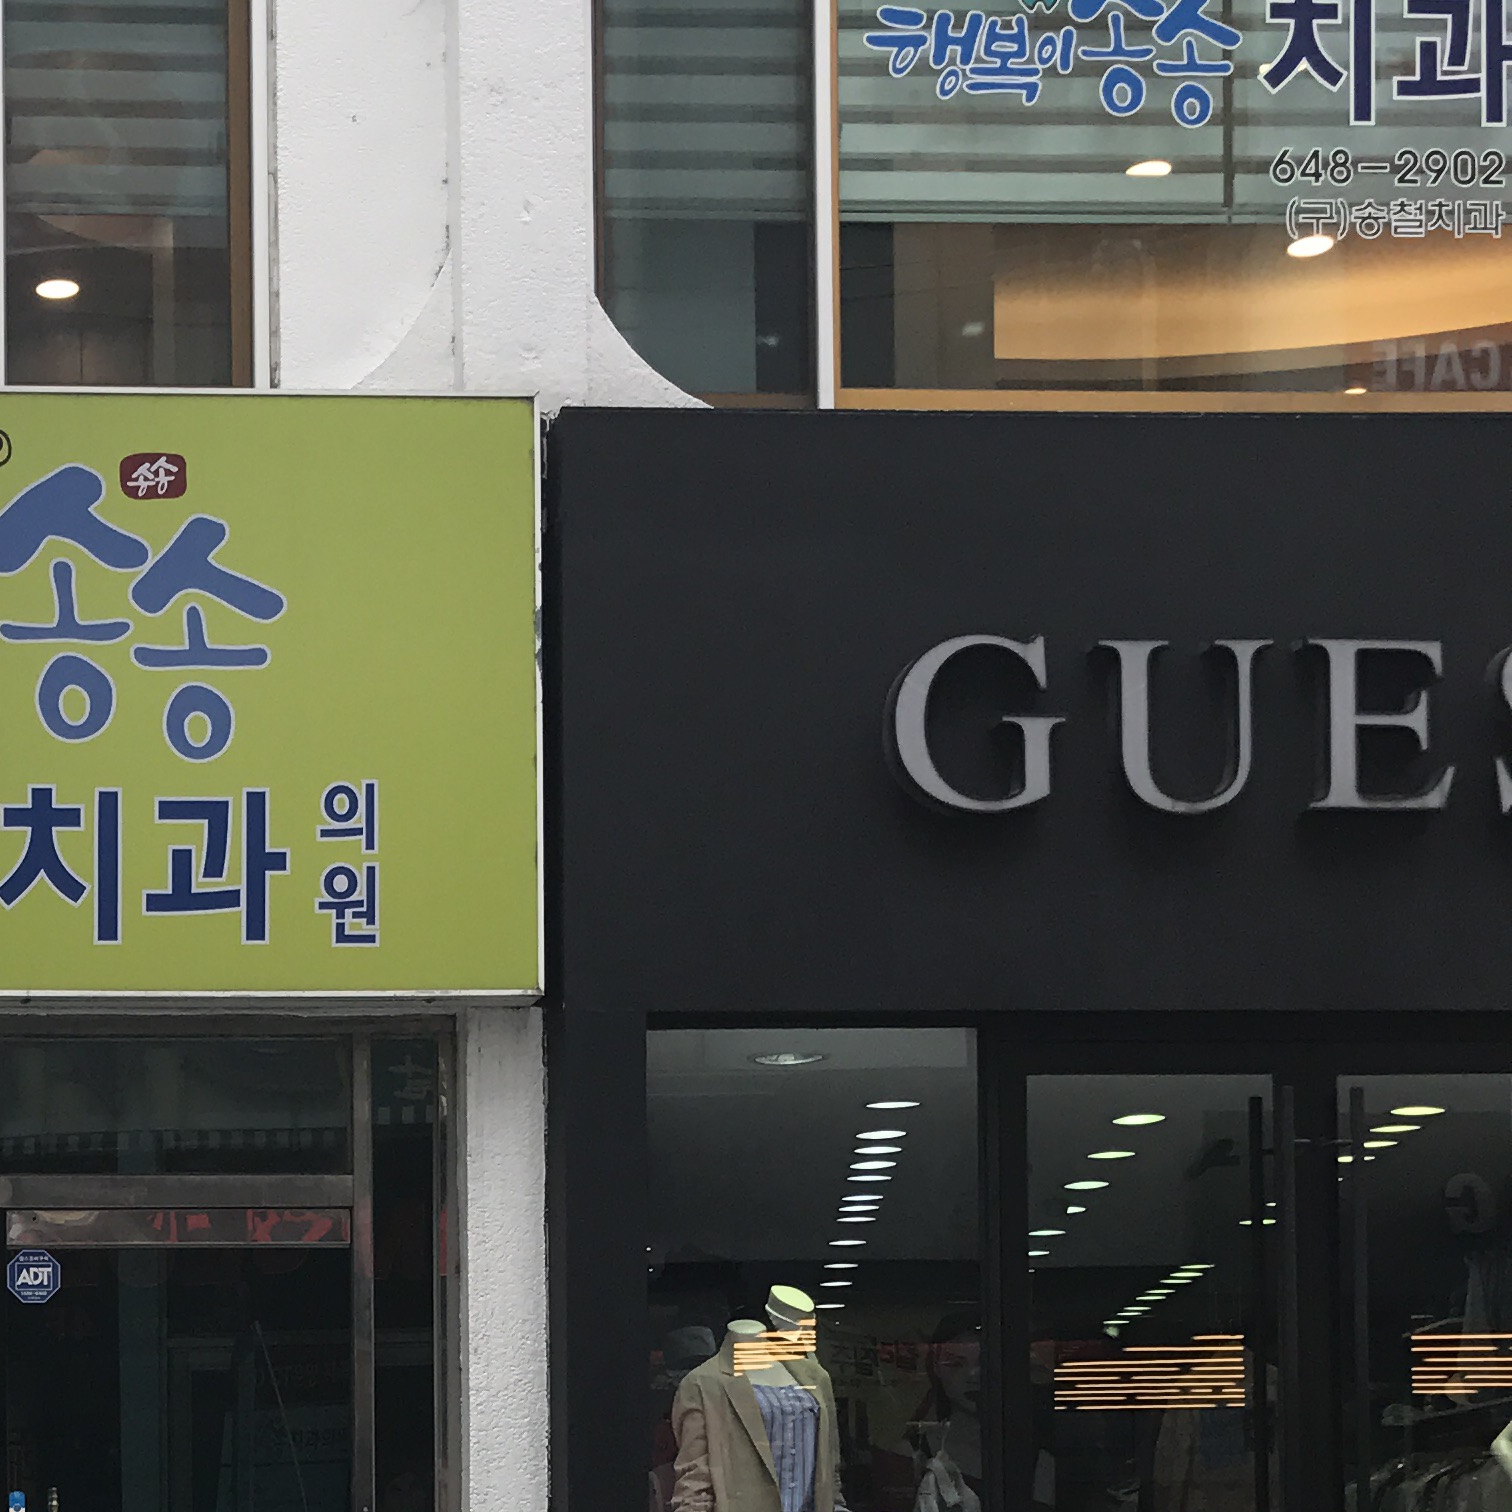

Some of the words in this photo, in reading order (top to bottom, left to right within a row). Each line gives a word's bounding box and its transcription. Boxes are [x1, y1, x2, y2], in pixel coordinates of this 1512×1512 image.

[1257, 0, 1512, 127] 치과
[1270, 147, 1506, 187] 648-2902
[1286, 197, 1506, 240] (구)송철치과
[17, 1267, 52, 1285] ADT
